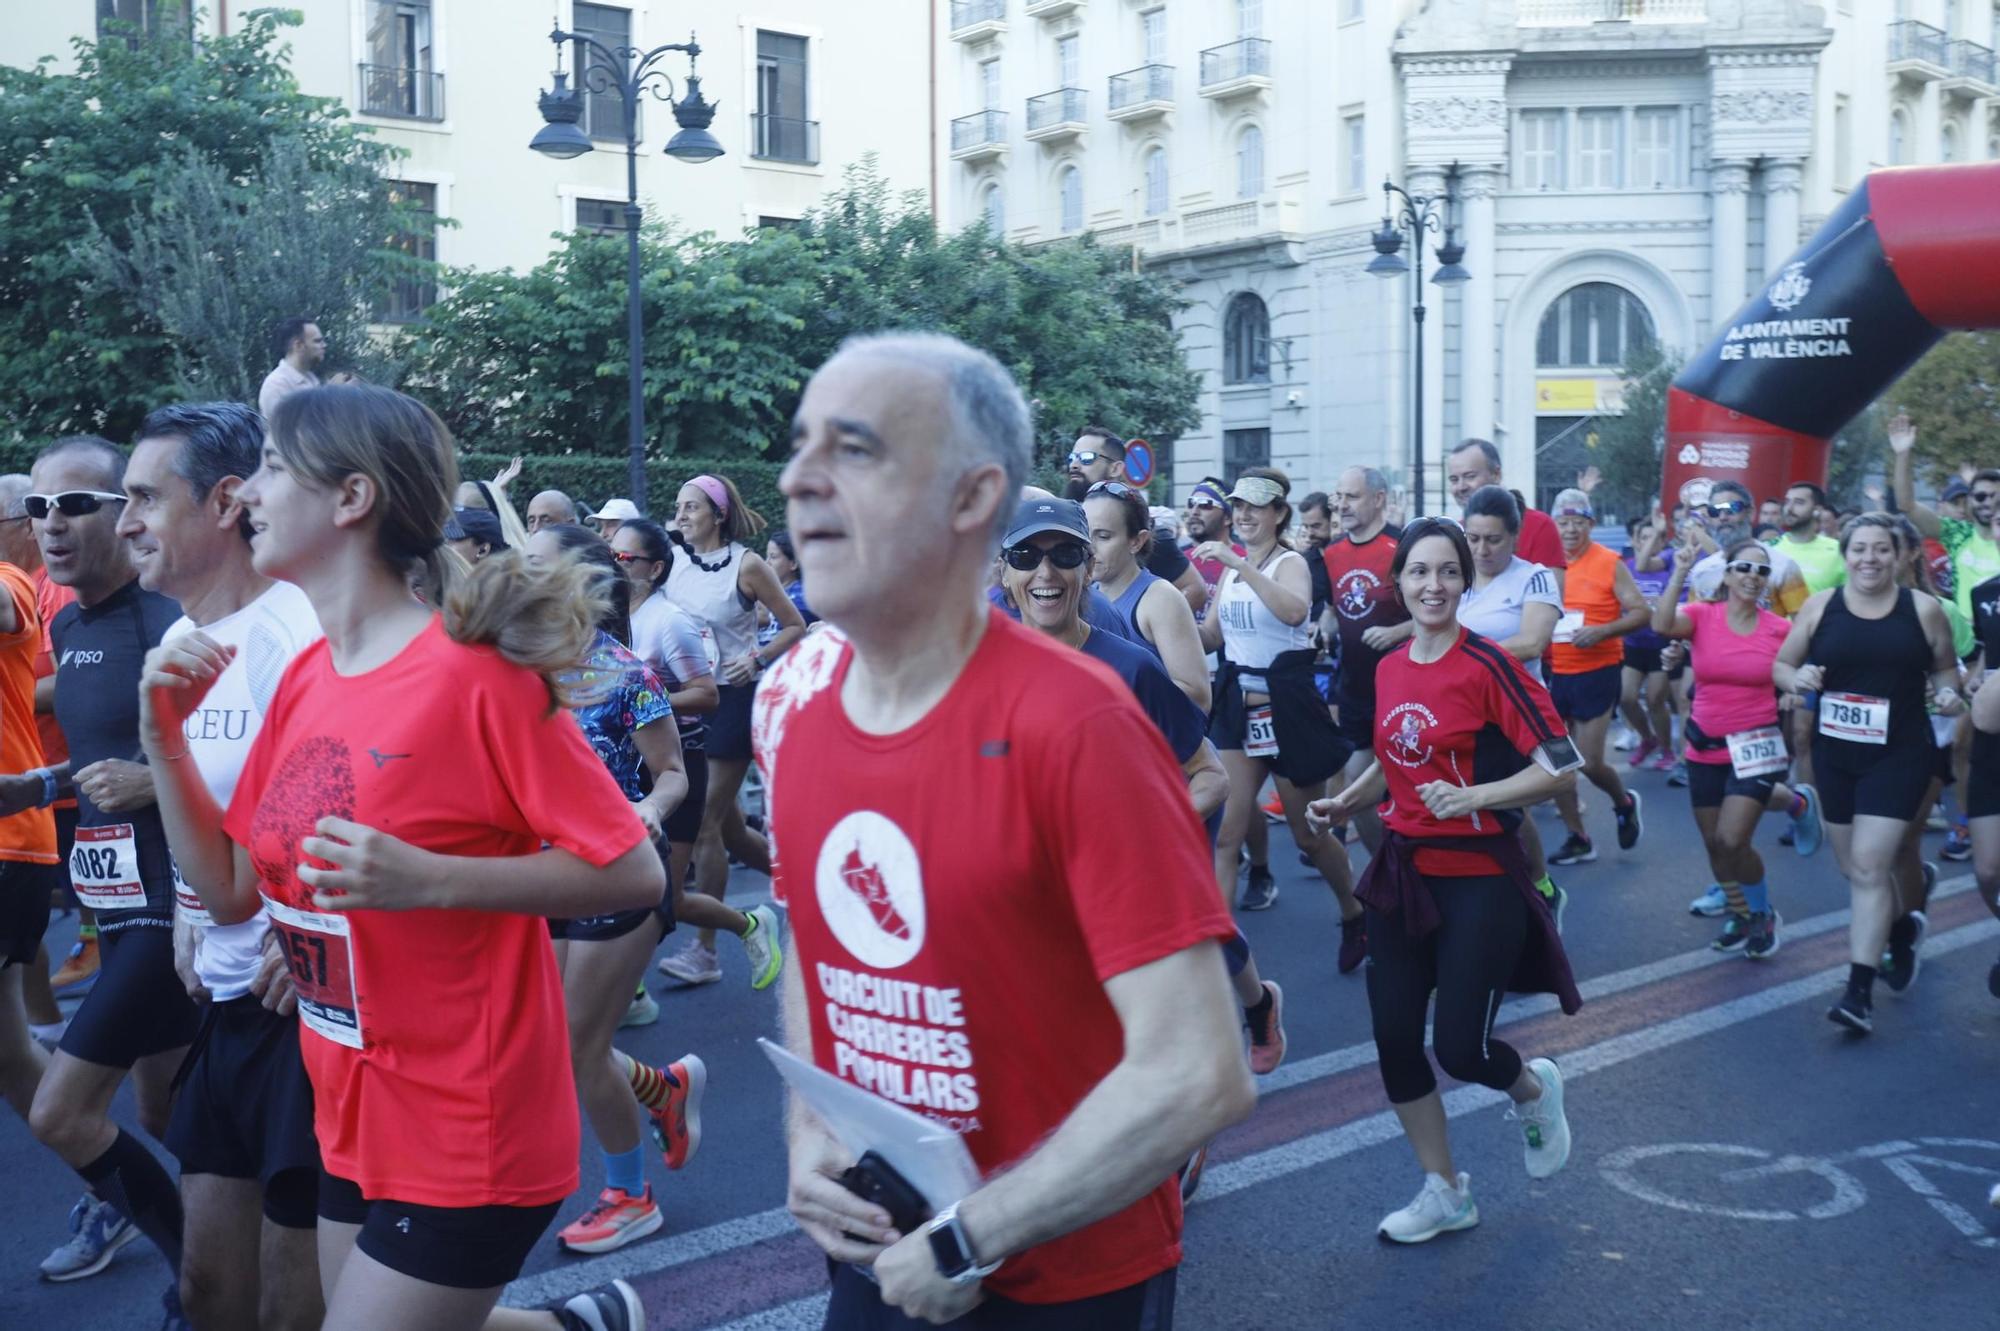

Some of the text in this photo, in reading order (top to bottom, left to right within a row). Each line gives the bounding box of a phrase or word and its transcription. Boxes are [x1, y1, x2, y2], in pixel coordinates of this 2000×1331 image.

[1725, 318, 1852, 342] AJUNTAMENT
[1720, 338, 1852, 361] DE VALÈNCIA
[1831, 702, 1872, 727] 7381
[1250, 722, 1273, 740] 51
[923, 985, 966, 1027] DE
